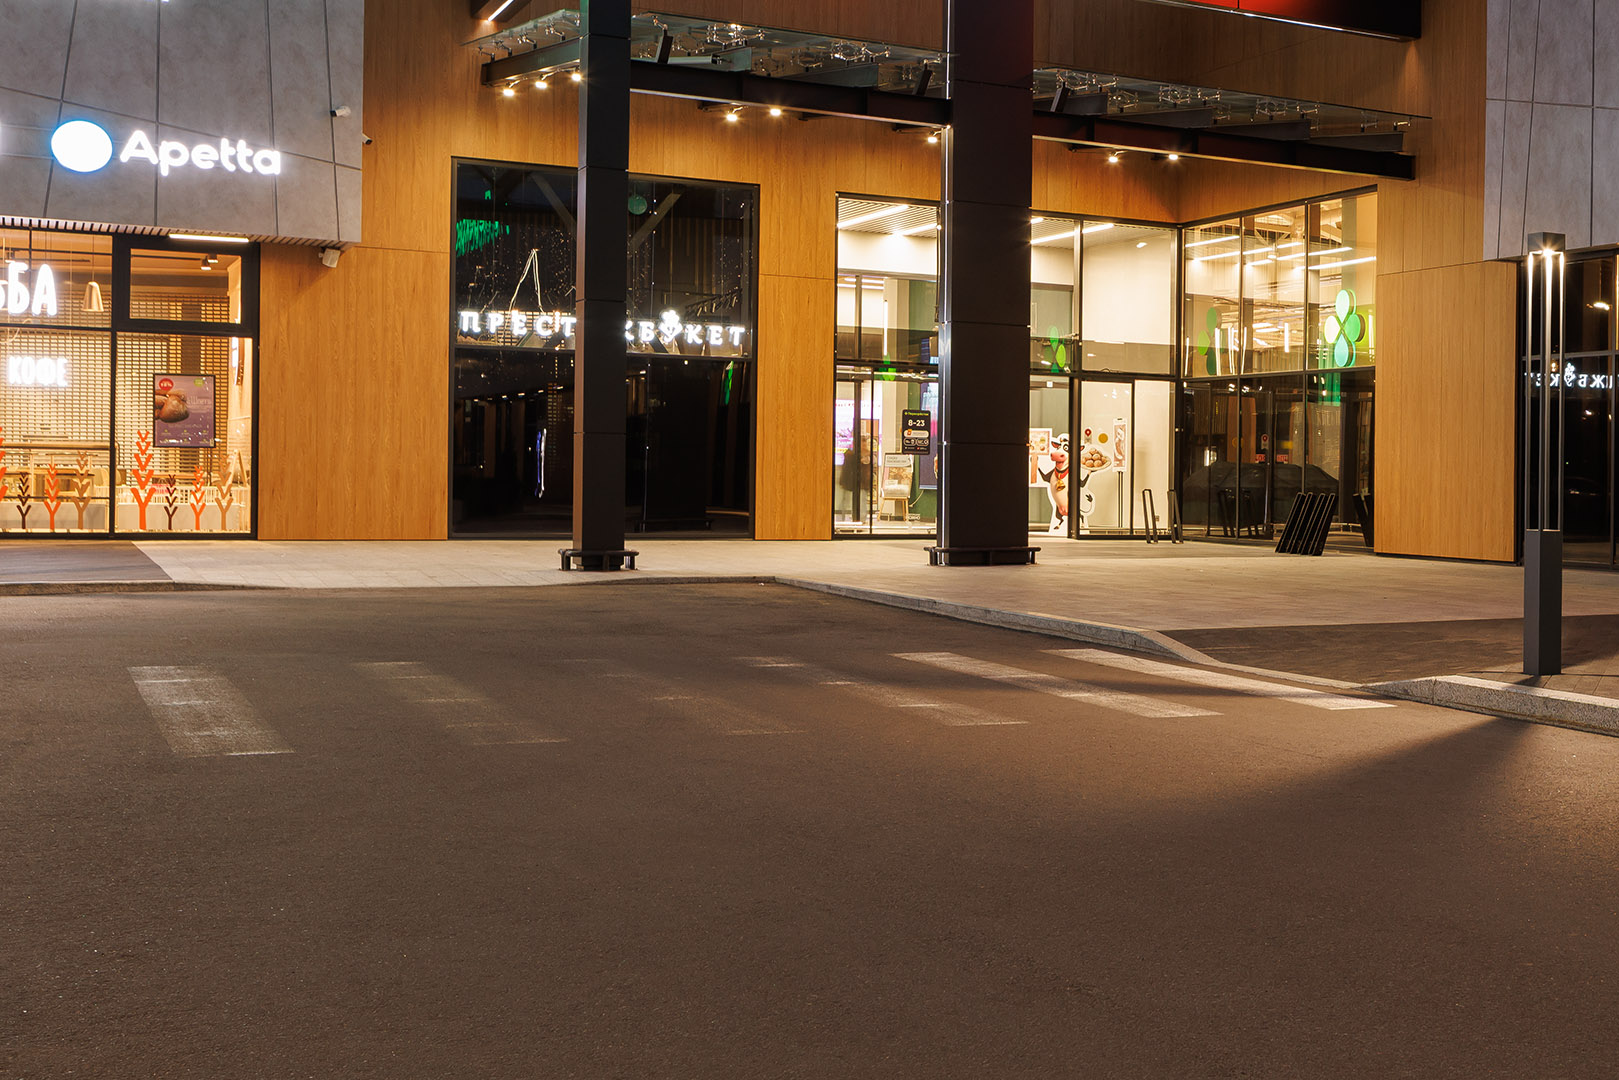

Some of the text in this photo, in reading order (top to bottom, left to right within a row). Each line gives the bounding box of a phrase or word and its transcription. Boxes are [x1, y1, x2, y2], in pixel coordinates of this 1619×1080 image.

[120, 130, 281, 176] Apetta
[0, 260, 57, 316] БА
[8, 356, 68, 387] КОФЕ
[907, 419, 925, 427] 8-23
